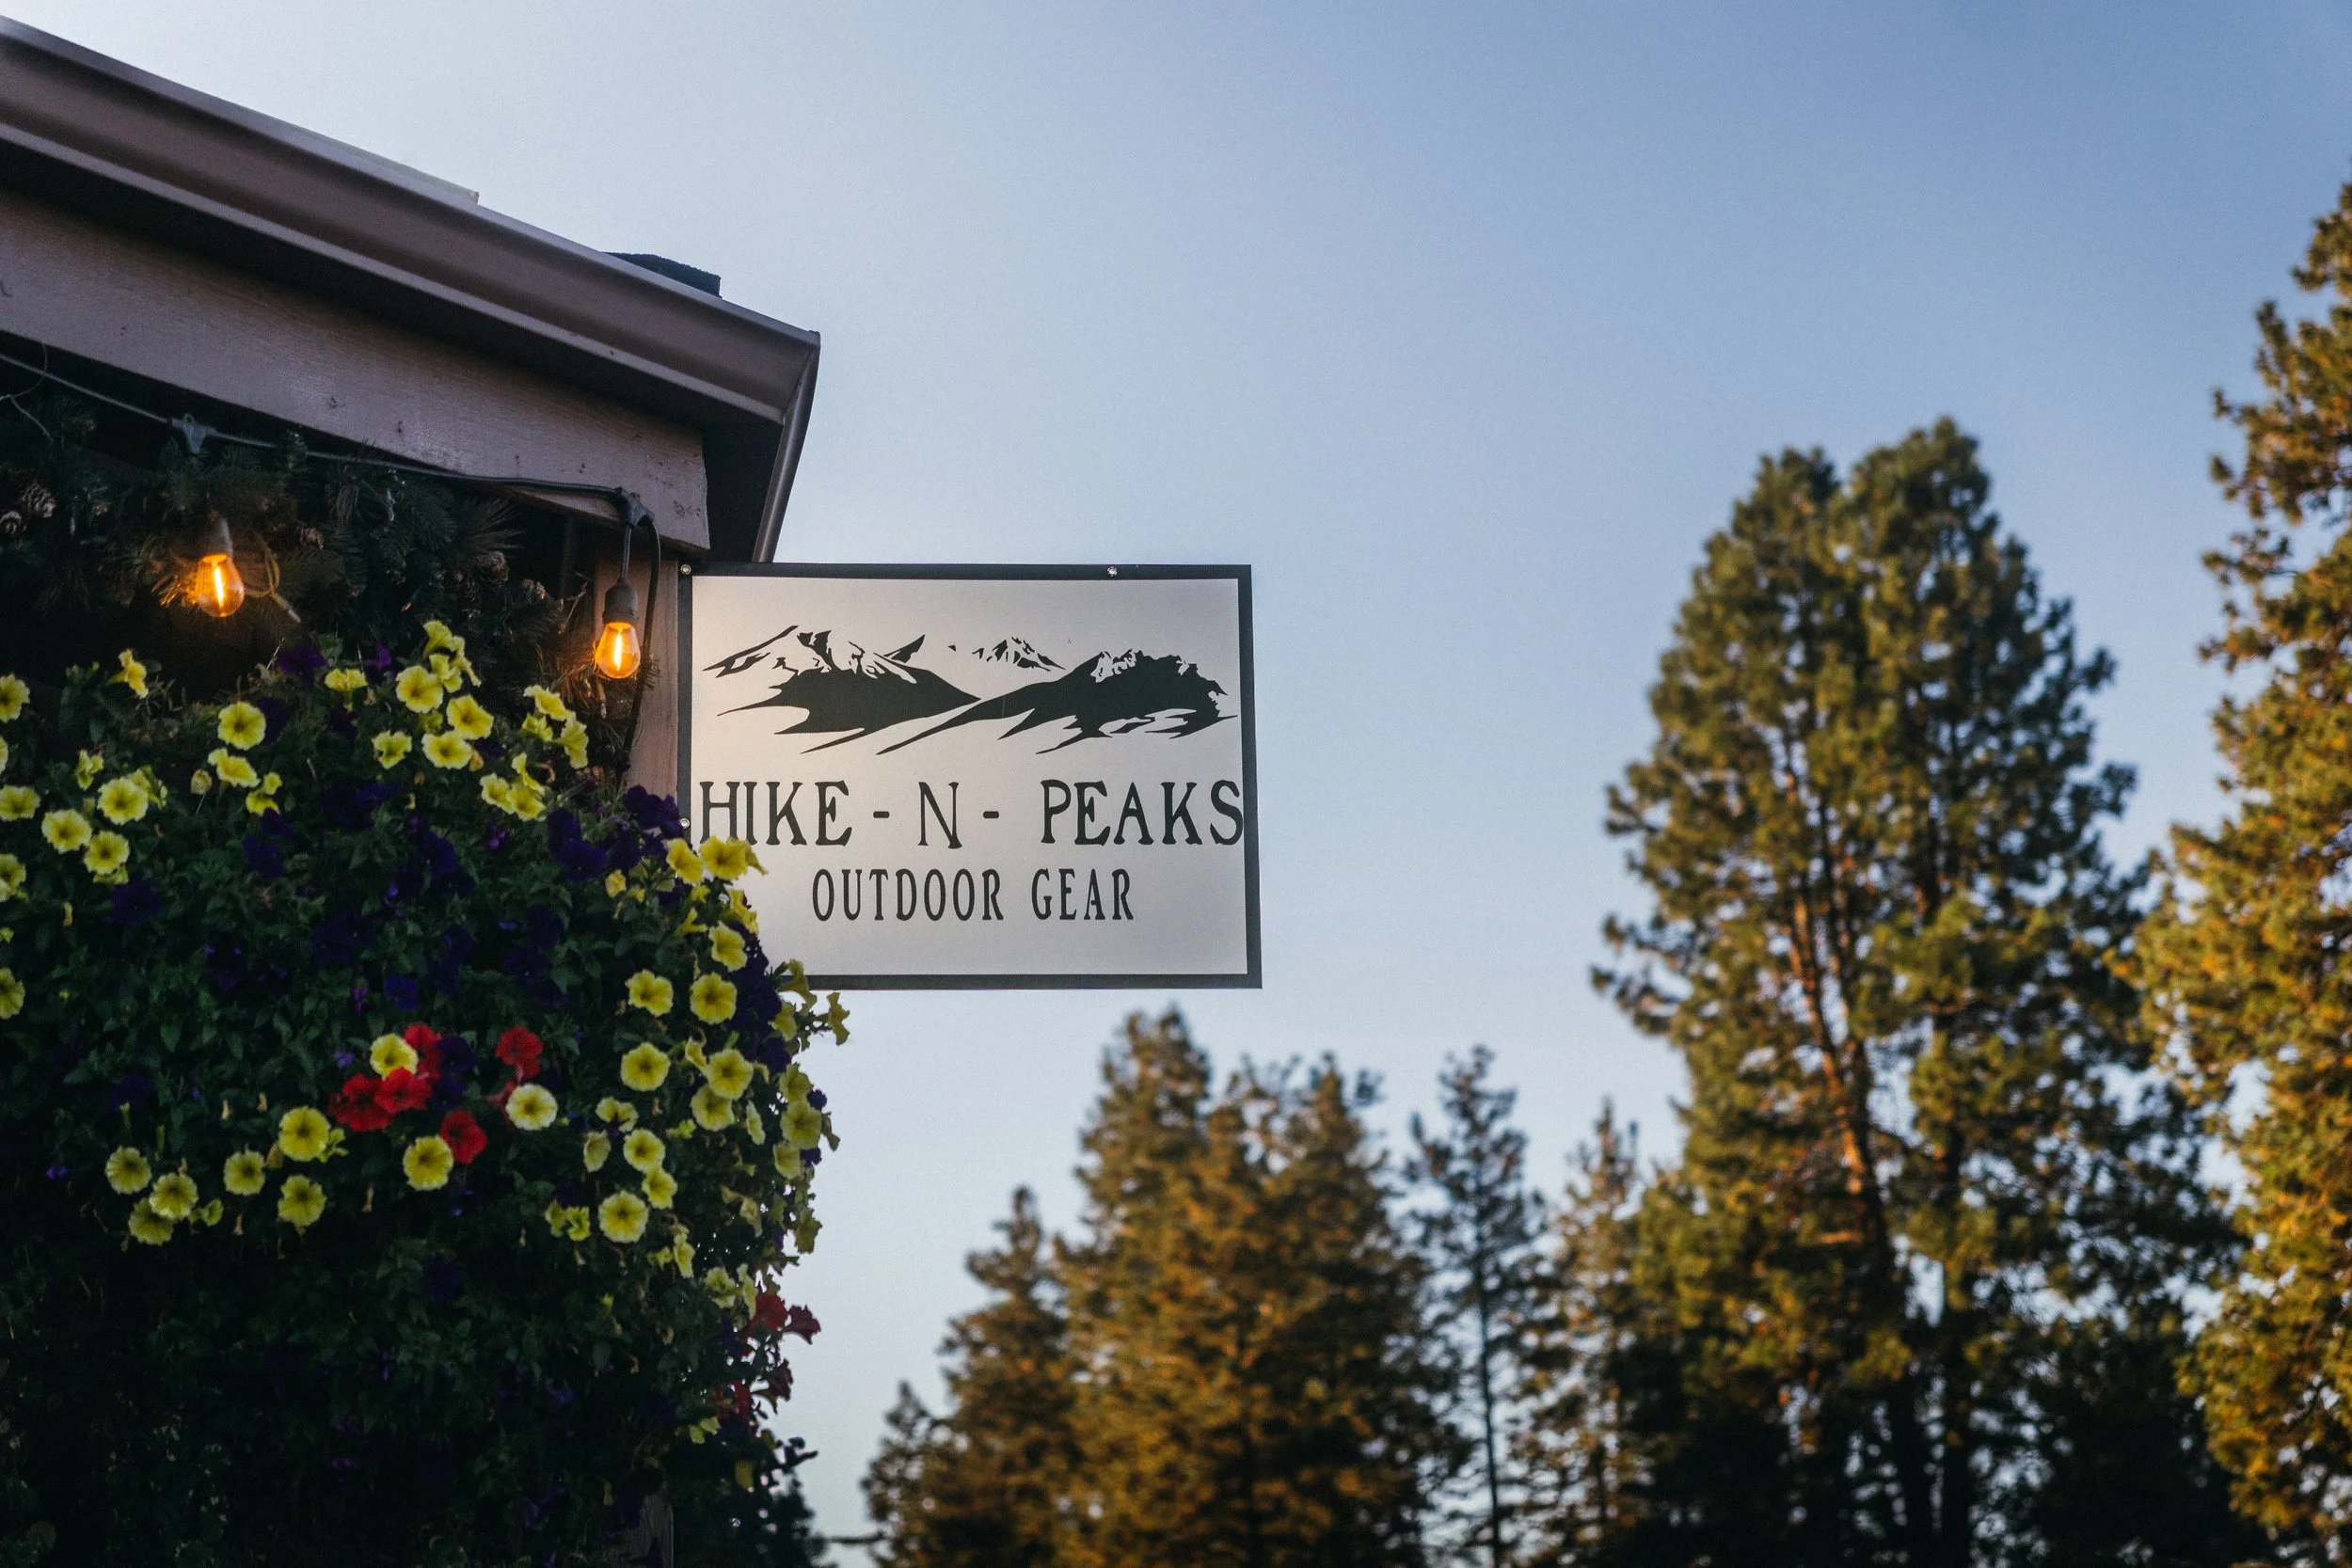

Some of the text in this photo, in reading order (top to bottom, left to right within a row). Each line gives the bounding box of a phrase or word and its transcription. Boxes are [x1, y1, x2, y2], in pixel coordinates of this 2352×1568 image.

[699, 780, 852, 847] HIKE
[1041, 779, 1244, 847] PEAKS
[812, 867, 1135, 922] OUTDOOR GEAR
